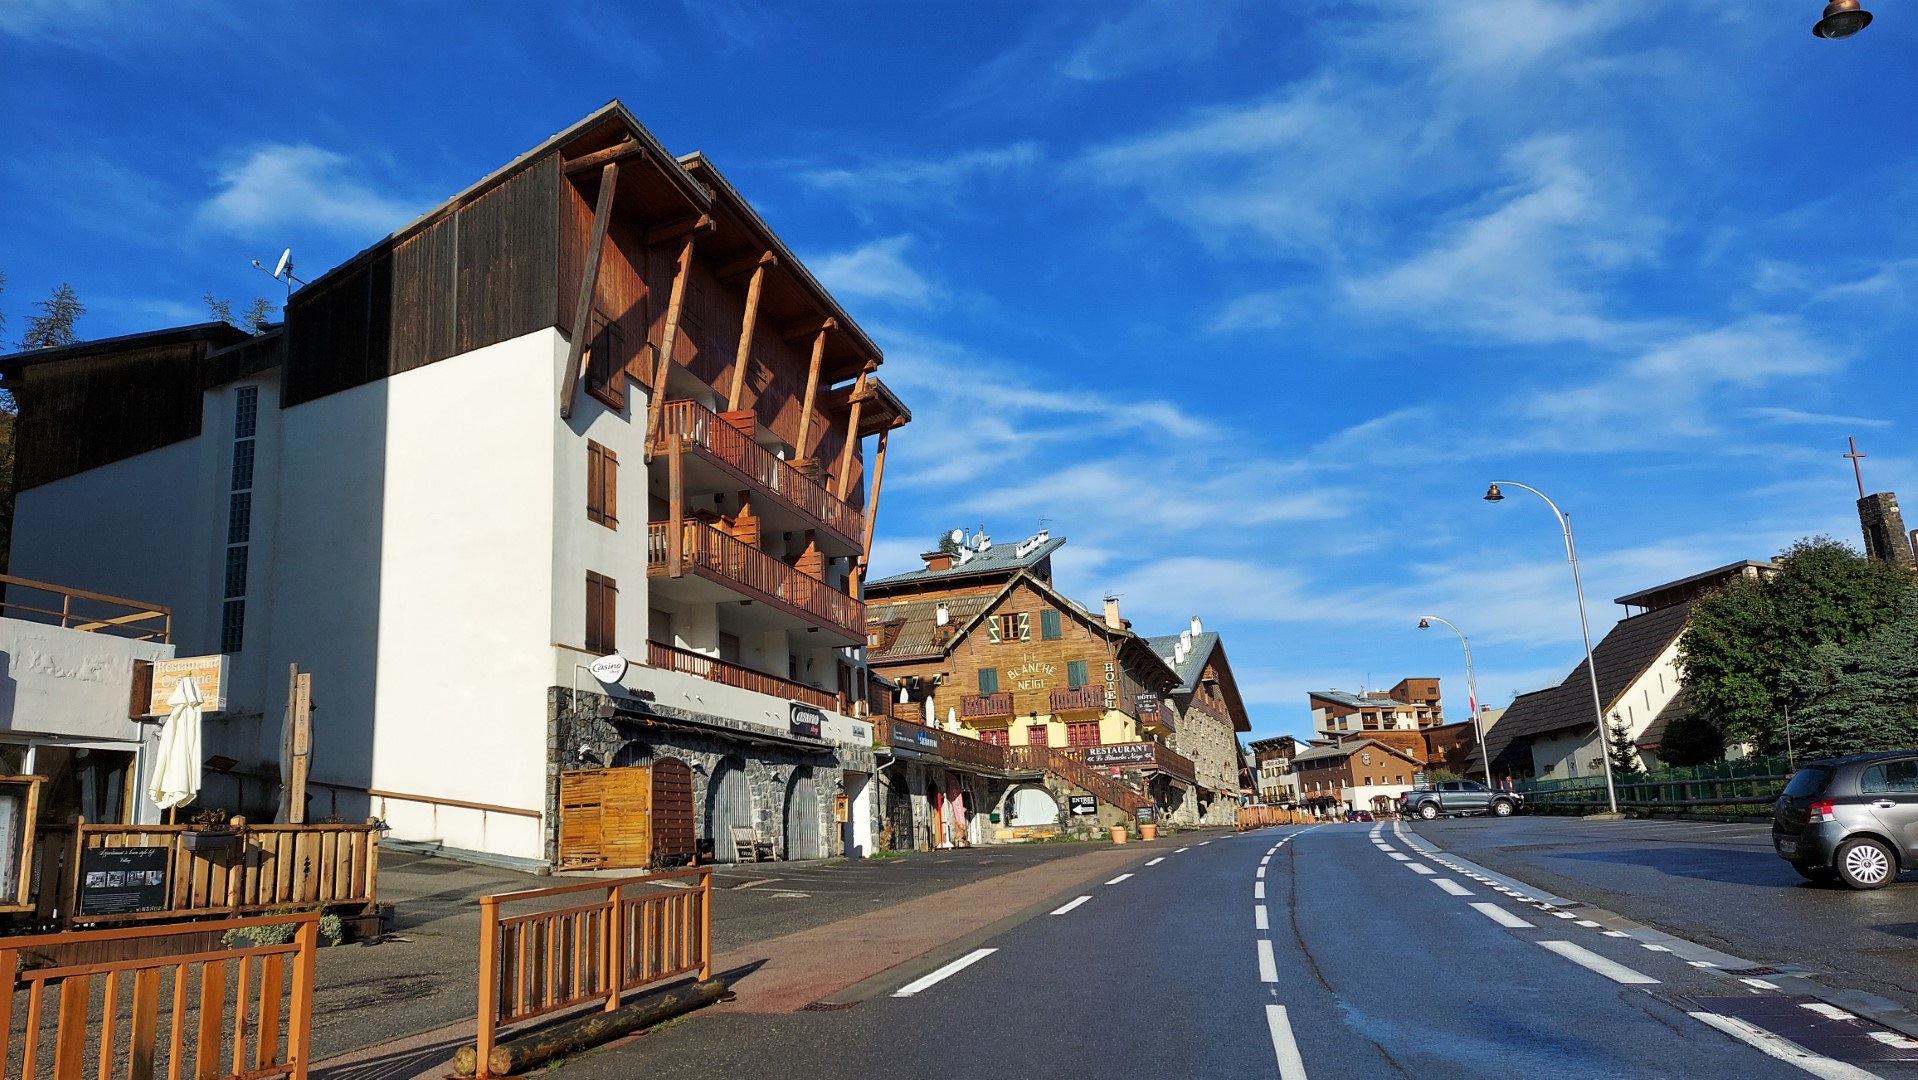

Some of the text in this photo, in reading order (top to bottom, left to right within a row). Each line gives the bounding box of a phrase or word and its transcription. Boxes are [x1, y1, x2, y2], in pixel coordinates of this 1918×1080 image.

[156, 659, 218, 673] Restaurant
[593, 662, 621, 673] Casino
[1104, 663, 1118, 709] HOTEL
[791, 706, 820, 726] Casino
[1090, 744, 1148, 756] RESTAURANT
